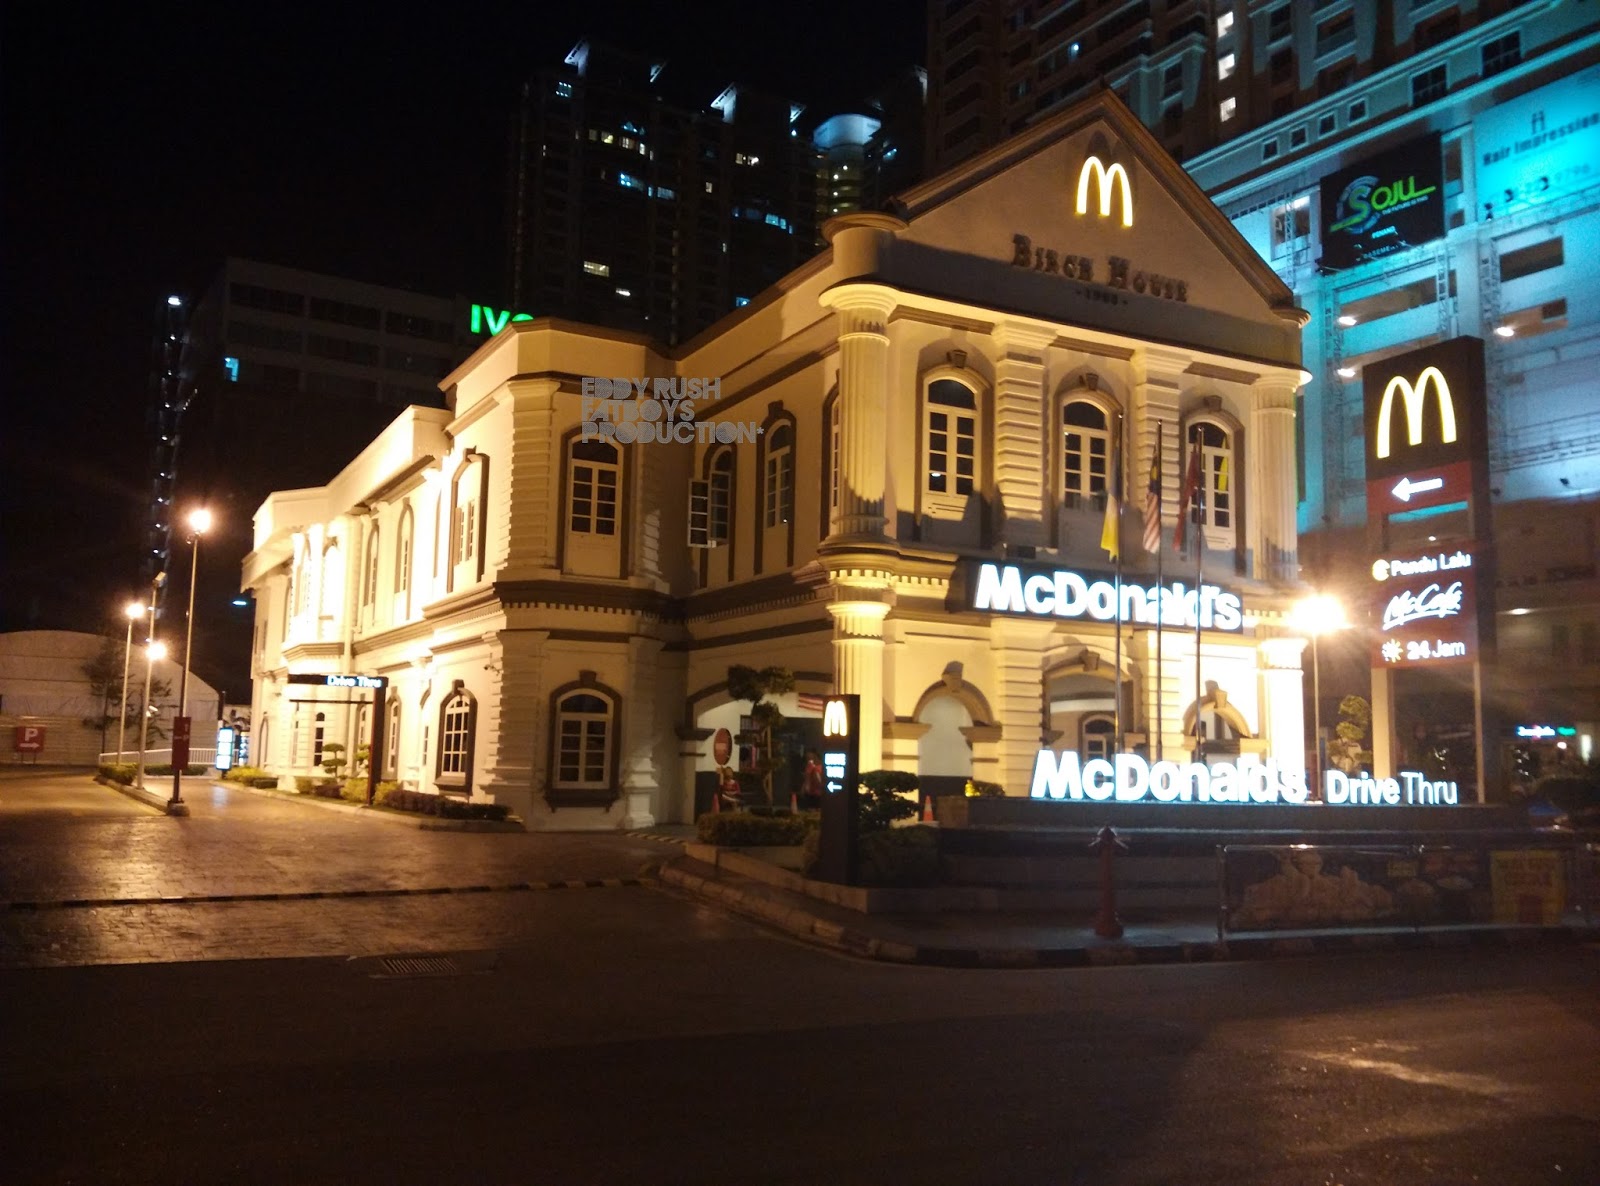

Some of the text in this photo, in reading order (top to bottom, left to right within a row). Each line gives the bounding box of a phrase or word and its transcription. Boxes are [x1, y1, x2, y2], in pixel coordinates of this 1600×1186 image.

[471, 304, 534, 337] IV
[1391, 551, 1471, 577] Pandu Lalu
[974, 563, 1242, 630] McDonald's
[1406, 639, 1466, 660] 24 Jam
[327, 675, 382, 688] Drive Thru
[25, 728, 39, 742] P
[1031, 749, 1308, 804] McDonald's
[1326, 769, 1458, 805] Drive Thru
